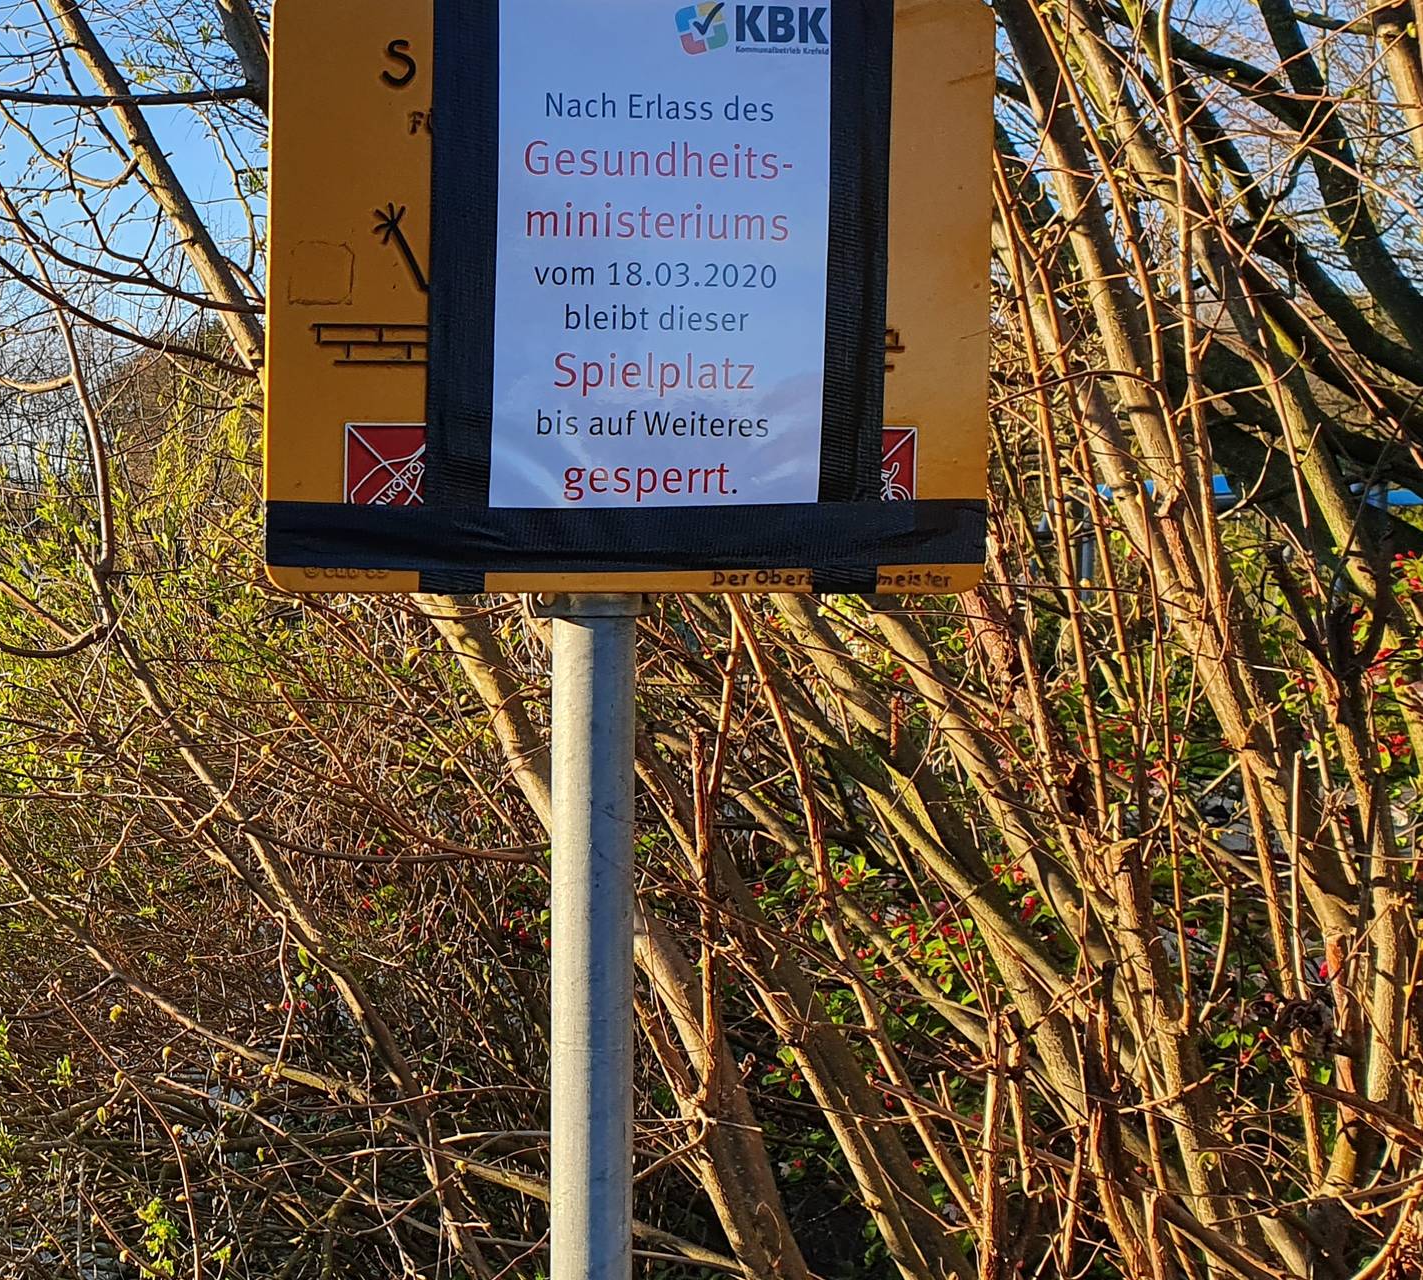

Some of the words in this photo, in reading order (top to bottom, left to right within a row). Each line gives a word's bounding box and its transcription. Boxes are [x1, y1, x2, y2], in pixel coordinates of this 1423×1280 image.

[735, 4, 829, 44] KBK
[735, 45, 801, 55] Kommunalbetrieb
[802, 47, 830, 56] Krefeld
[544, 91, 617, 119] Nach
[628, 93, 714, 120] Erlass
[723, 95, 775, 123] des
[524, 139, 794, 180] Gesundheits-
[526, 201, 790, 242] ministeriums
[533, 265, 595, 286] vom
[607, 261, 778, 289] 18.03.2020
[564, 303, 650, 331] bleibt
[658, 304, 750, 332] dieser
[553, 351, 756, 398] Spielplatz
[535, 408, 579, 437] bis
[588, 409, 638, 437] auf
[643, 410, 770, 439] Weiteres
[562, 462, 739, 503] gesperrt.
[712, 569, 750, 588] Der
